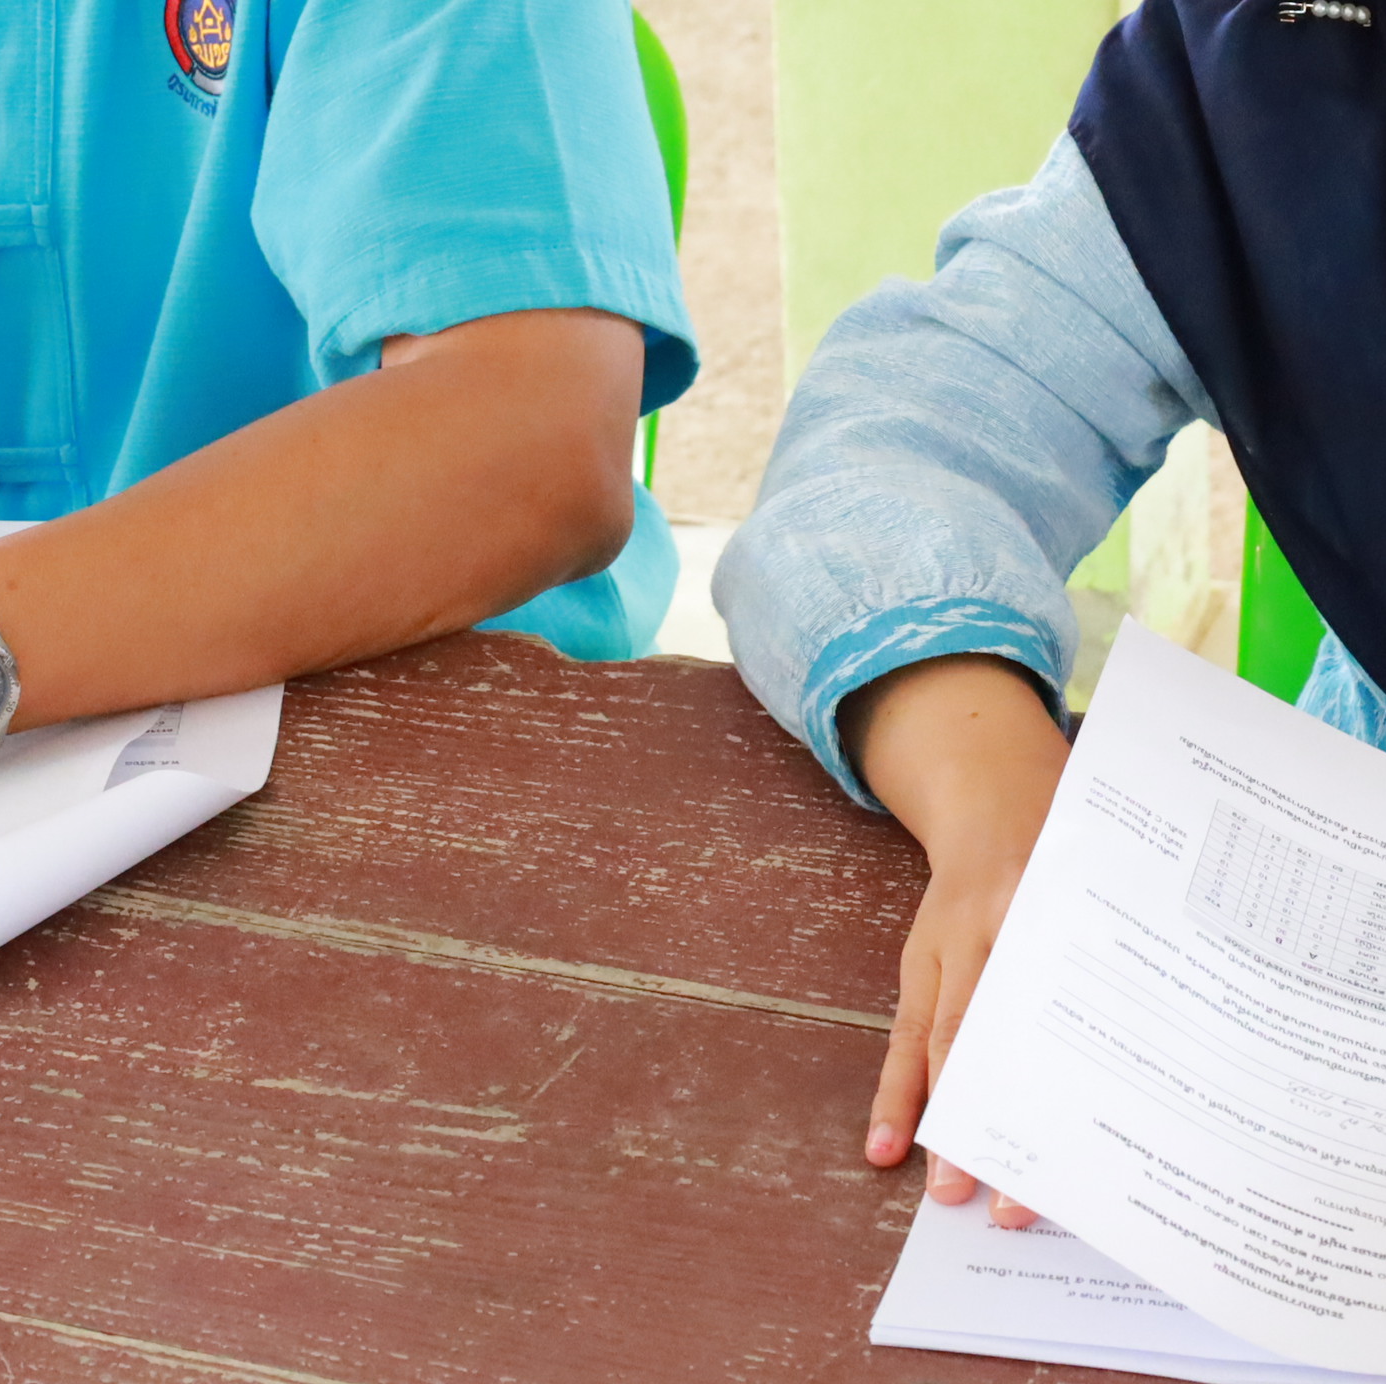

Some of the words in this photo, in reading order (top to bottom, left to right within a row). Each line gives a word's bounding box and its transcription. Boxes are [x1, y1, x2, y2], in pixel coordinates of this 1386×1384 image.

[1223, 935, 1251, 957] 2568
[1115, 939, 1167, 979] จังหวัดยะลา
[1228, 953, 1265, 981] ประจำปี
[1253, 953, 1292, 978] ประจำปี
[1109, 1036, 1166, 1078] พฤศจิกายน
[1329, 1046, 1367, 1066] หมู่บ้าน
[1169, 1074, 1195, 1096] เดือน
[1208, 1099, 1266, 1132] เมื่อวันพุธที่
[1092, 1118, 1154, 1161] จังหวัดยะลา
[1321, 1151, 1351, 1167] ครั้งที่
[1158, 1158, 1234, 1205] อำเภอกรงปินัง
[1238, 1202, 1303, 1236] ตำบลสะเอะ
[1320, 1236, 1347, 1252] หมู่ที่
[1017, 1268, 1070, 1285] โครงการ
[1295, 1266, 1328, 1283] ครั้งที่
[1312, 1254, 1373, 1277] พฤษภาคม
[1213, 1263, 1344, 1320] ระเบียบวาระการประชุม
